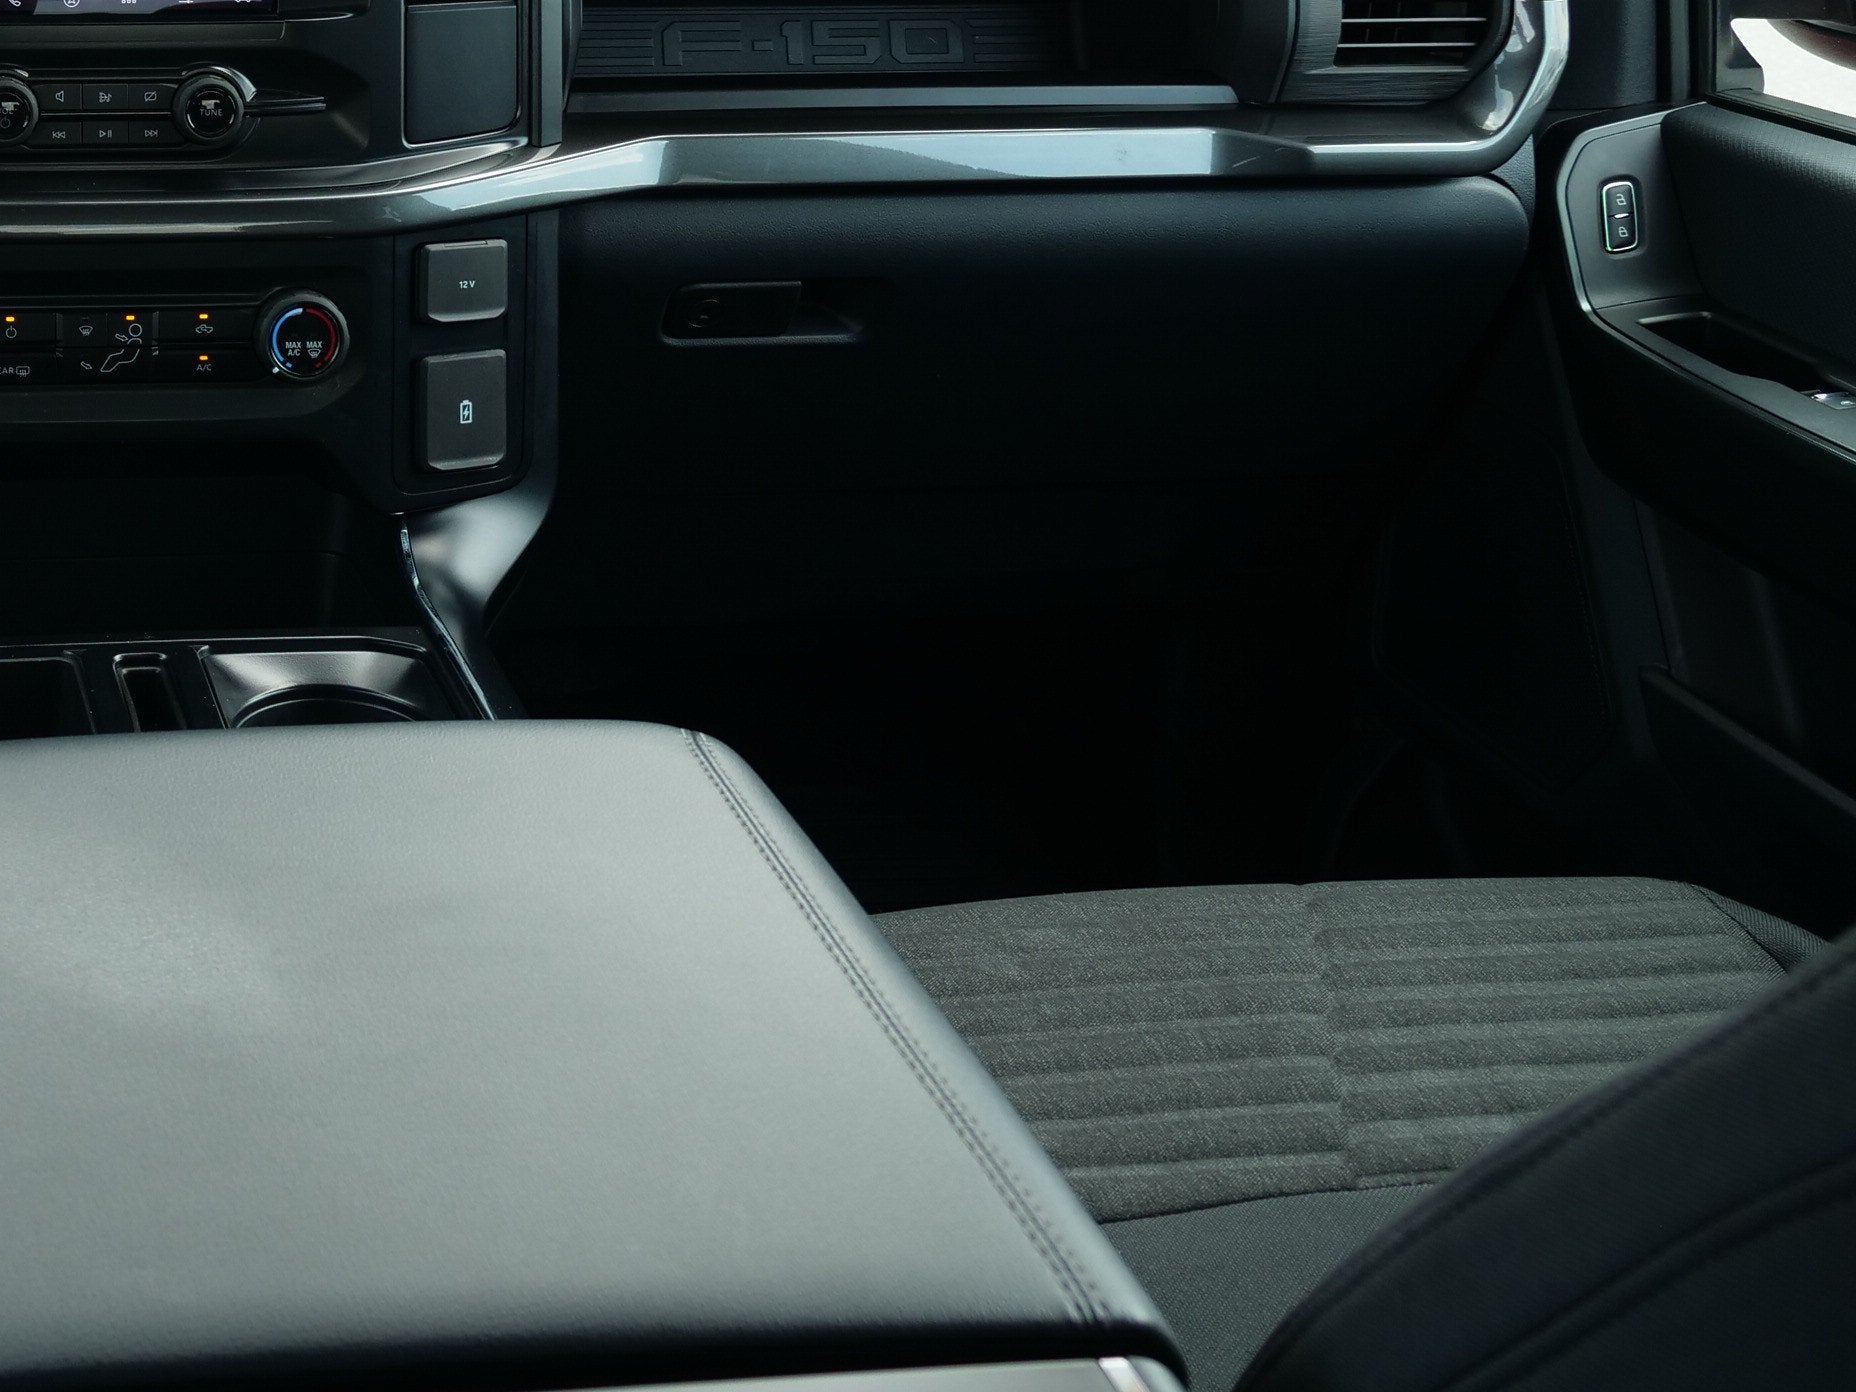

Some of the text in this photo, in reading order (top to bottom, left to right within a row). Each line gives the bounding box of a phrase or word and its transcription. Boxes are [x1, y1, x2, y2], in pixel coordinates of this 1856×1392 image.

[661, 19, 965, 67] F-150
[198, 107, 223, 116] TUNE
[458, 280, 469, 289] 12
[285, 341, 302, 349] MAX
[196, 362, 212, 372] A/C
